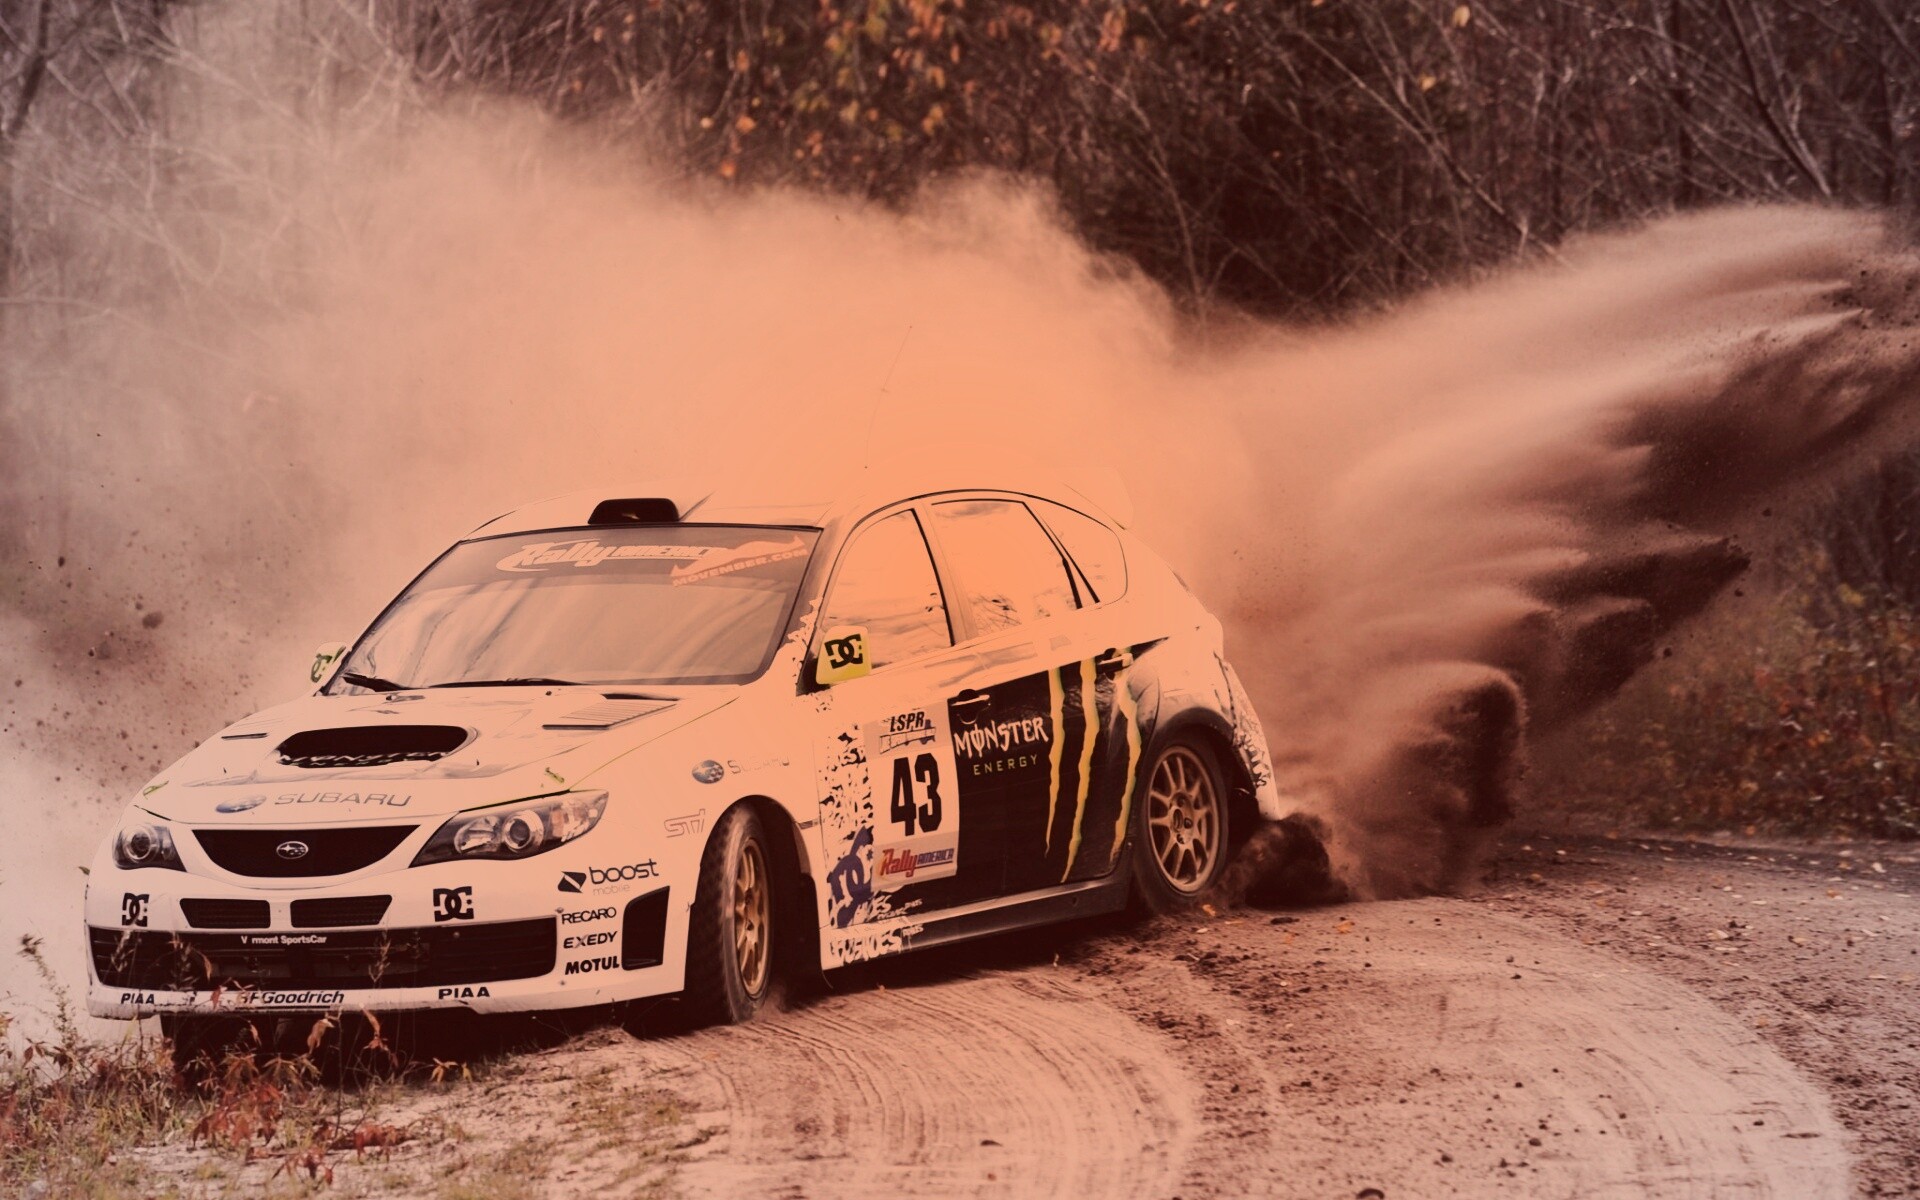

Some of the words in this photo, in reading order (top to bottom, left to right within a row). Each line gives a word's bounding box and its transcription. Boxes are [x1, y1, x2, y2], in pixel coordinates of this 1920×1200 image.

[889, 711, 925, 732] LSPR
[973, 754, 1039, 776] ENERGY
[275, 792, 412, 807] SUBARU
[890, 753, 942, 837] 43
[589, 859, 659, 884] boost
[880, 848, 918, 878] Rally
[561, 907, 617, 924] RECARO
[241, 936, 279, 944] Vrmont
[280, 935, 327, 945] SportsCar
[563, 931, 618, 949] EXEDY
[565, 956, 620, 975] MOTUL
[120, 993, 155, 1005] PIAA
[438, 986, 490, 1000] PIAA
